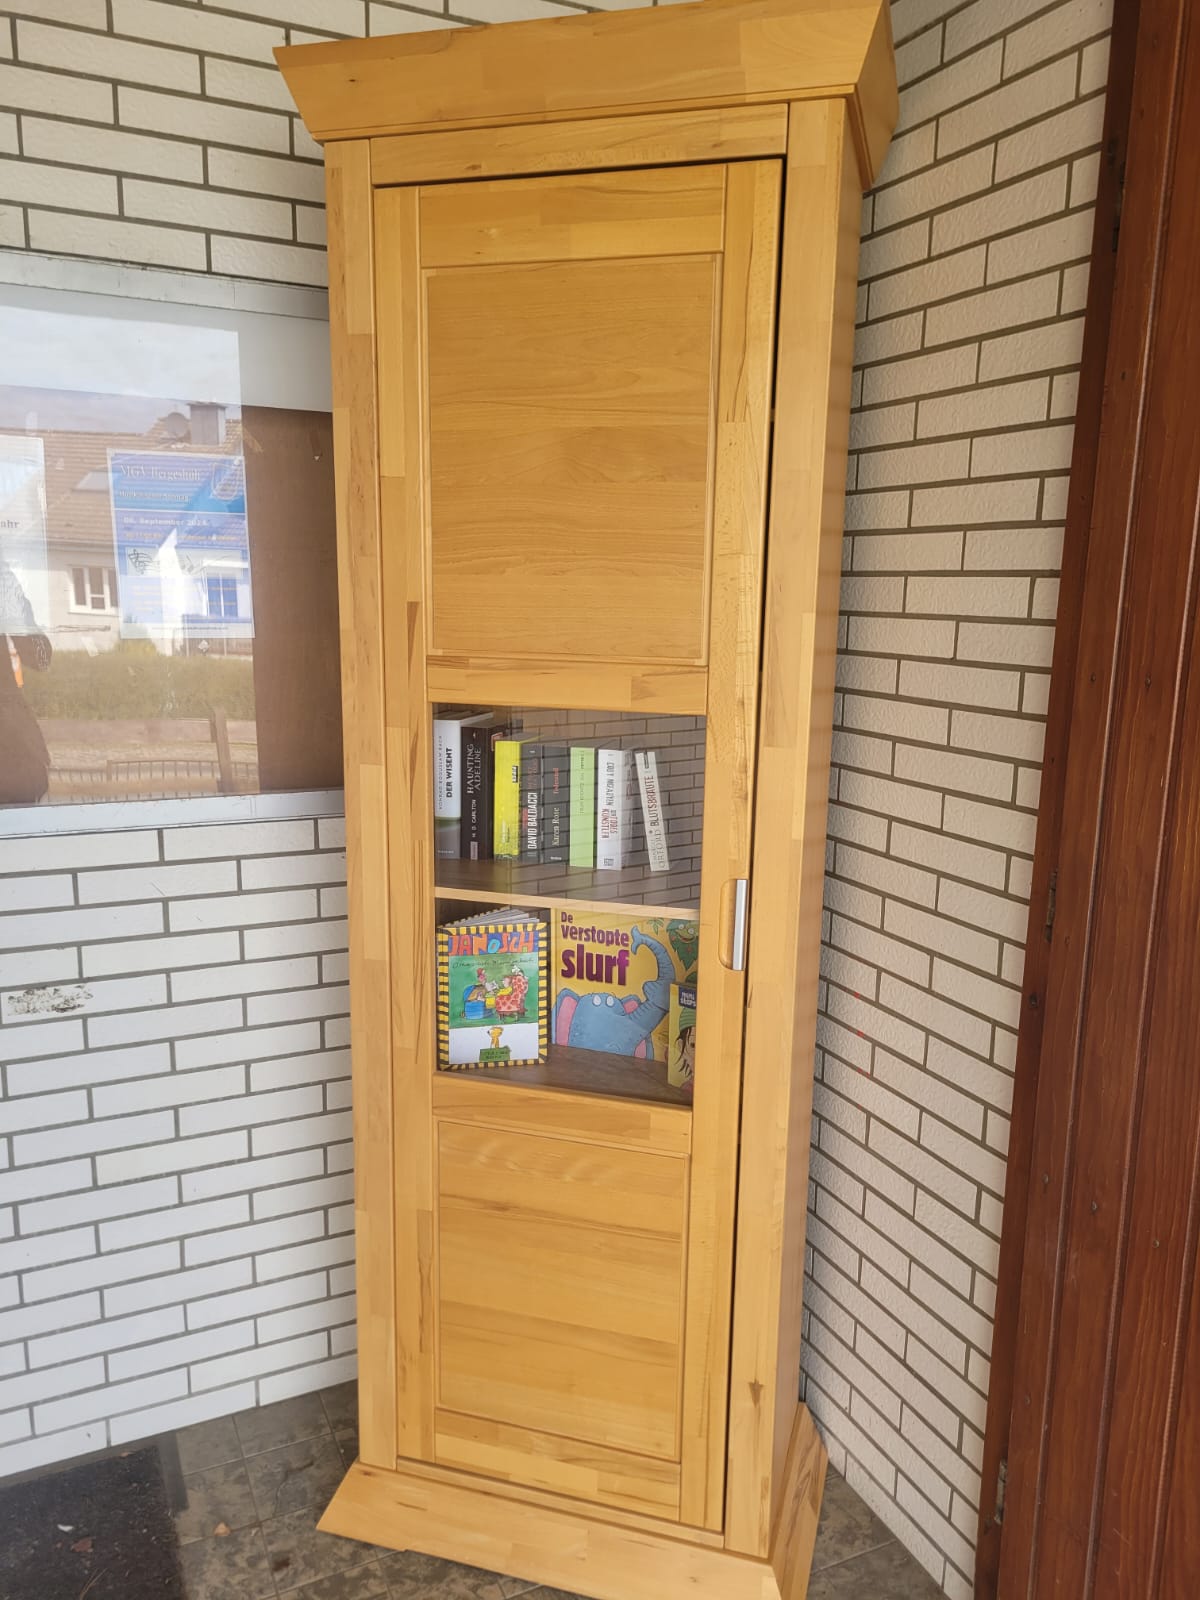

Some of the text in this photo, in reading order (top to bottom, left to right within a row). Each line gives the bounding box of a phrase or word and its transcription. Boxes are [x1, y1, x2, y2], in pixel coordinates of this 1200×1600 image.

[445, 747, 453, 798] DER WISENT
[466, 743, 475, 794] HAUNTING
[474, 747, 482, 791] ADELINE
[527, 792, 538, 827] BALDACCI
[552, 807, 560, 824] Rose
[527, 828, 538, 849] DAVID
[551, 825, 560, 846] Karen
[560, 911, 574, 924] De
[449, 930, 534, 956] JANOSCH
[560, 924, 630, 948] verstopte
[560, 943, 631, 987] slurf
